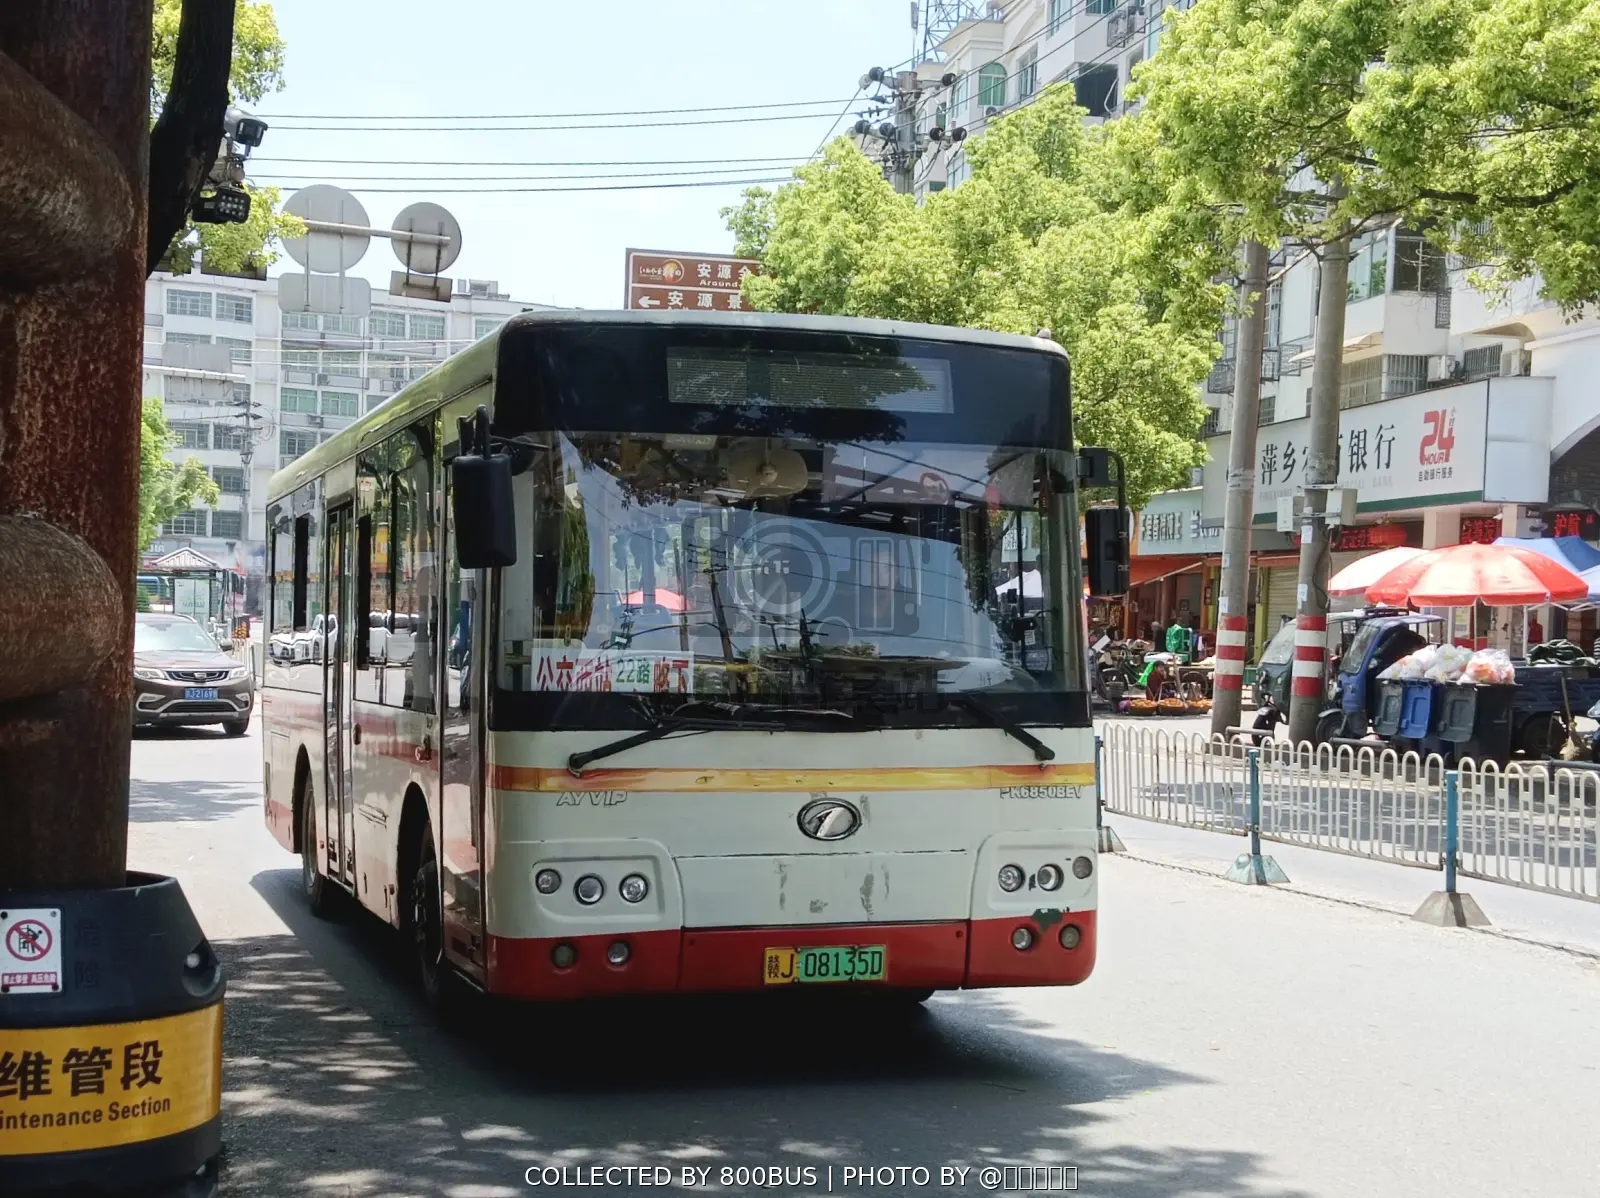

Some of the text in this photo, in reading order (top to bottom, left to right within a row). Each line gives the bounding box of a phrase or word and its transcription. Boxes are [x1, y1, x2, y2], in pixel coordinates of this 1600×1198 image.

[1261, 424, 1396, 486] 萍乡银行
[1419, 409, 1454, 465] 24
[1424, 452, 1445, 466] HOUR
[108, 1096, 171, 1122] Section
